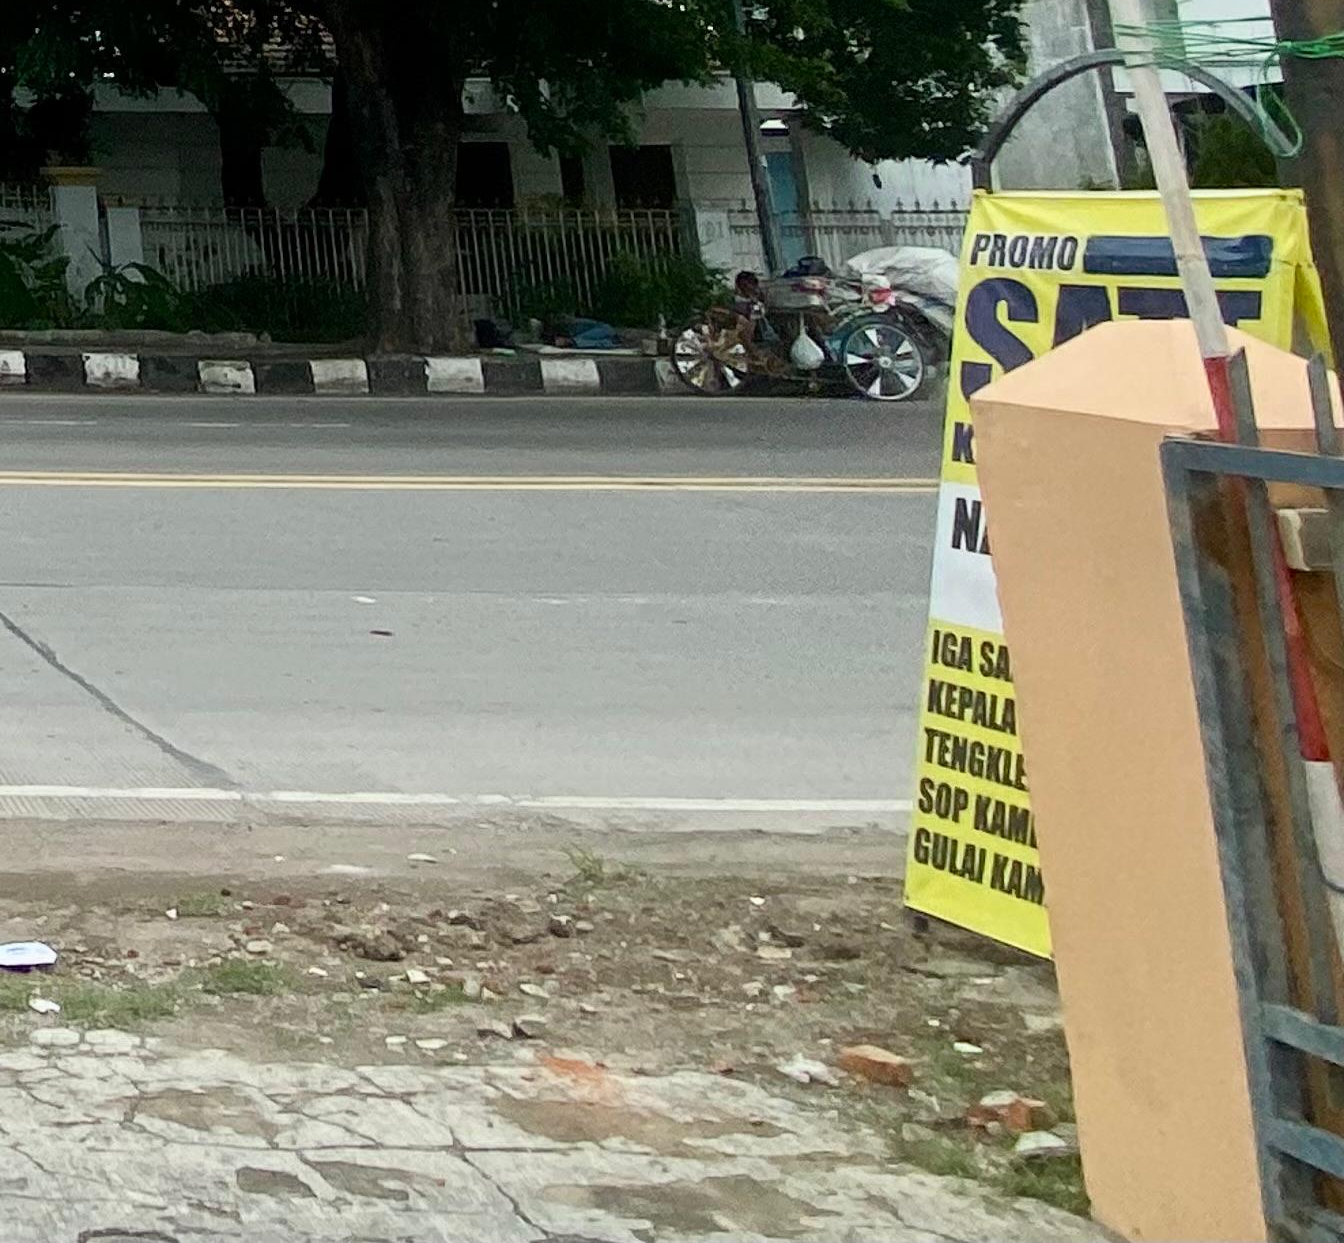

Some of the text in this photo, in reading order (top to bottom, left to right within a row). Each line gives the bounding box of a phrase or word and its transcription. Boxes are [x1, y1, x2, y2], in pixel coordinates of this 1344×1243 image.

[969, 233, 1079, 271] PROMO
[931, 629, 973, 673] IGA
[927, 679, 1017, 736] KEPALA
[918, 777, 968, 823] SOP
[913, 827, 986, 885] GULAI
